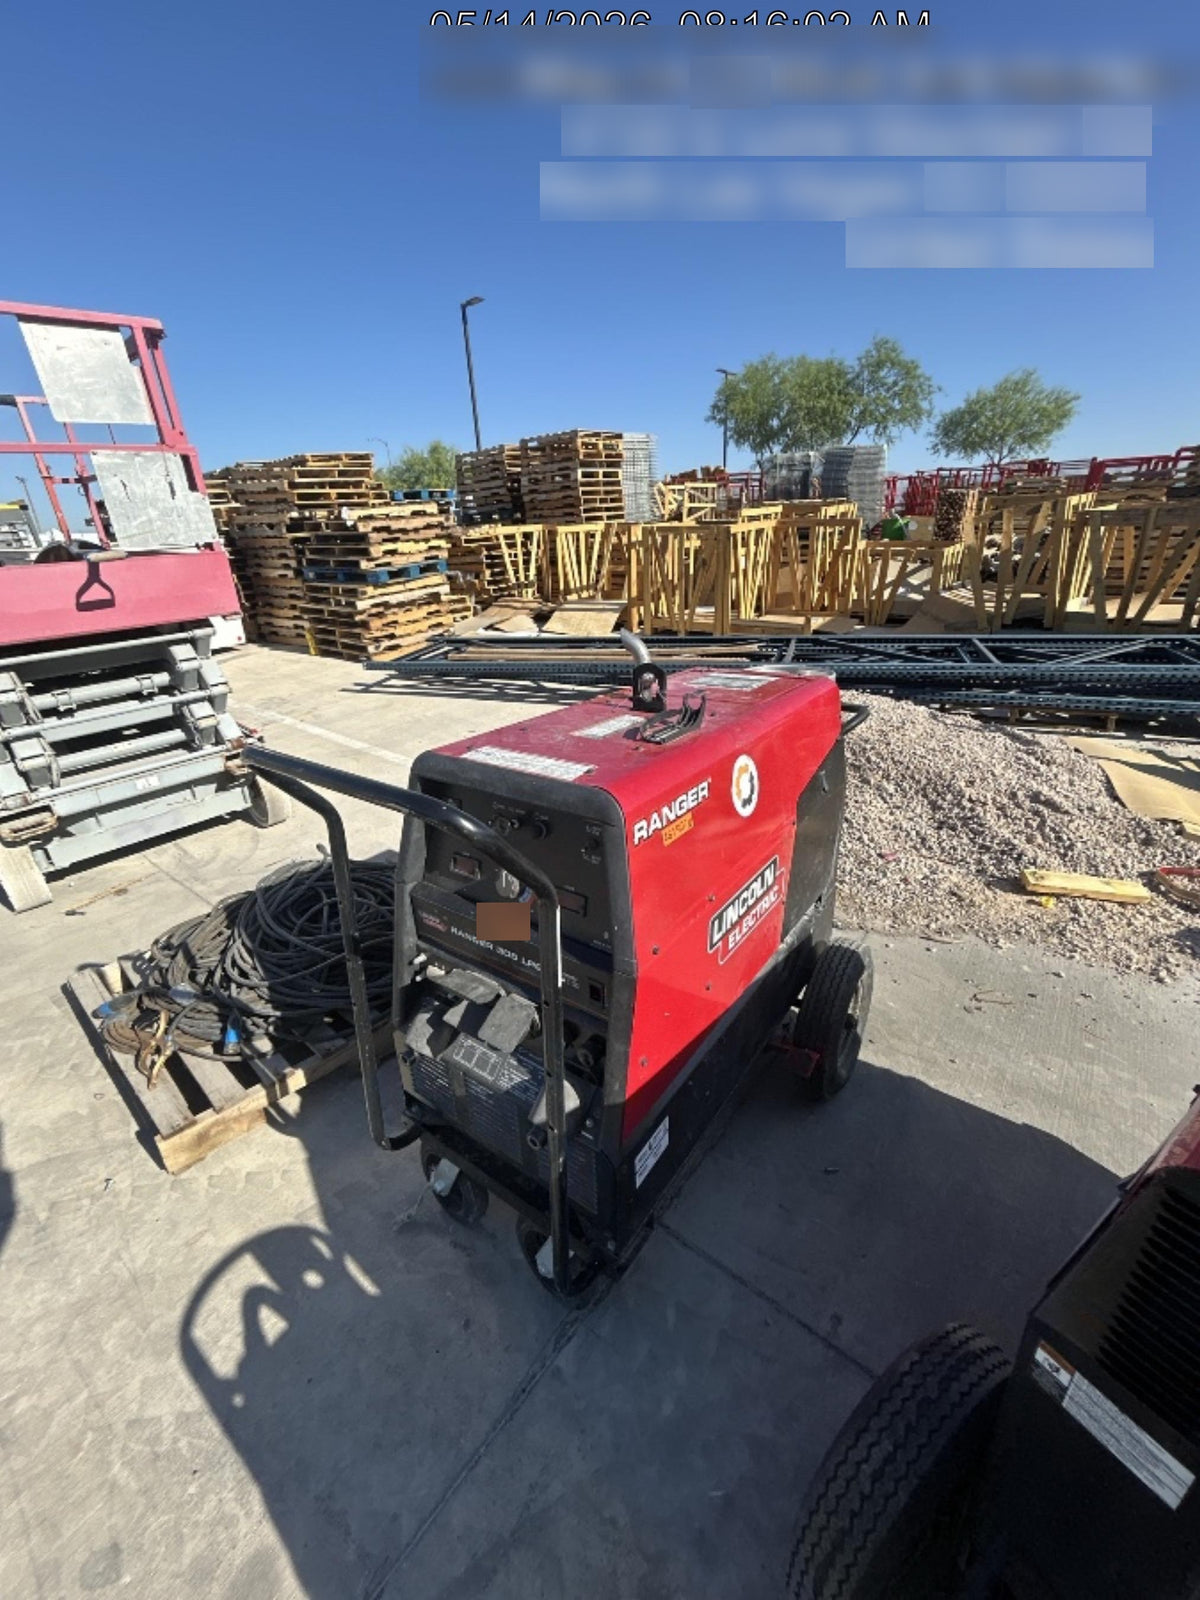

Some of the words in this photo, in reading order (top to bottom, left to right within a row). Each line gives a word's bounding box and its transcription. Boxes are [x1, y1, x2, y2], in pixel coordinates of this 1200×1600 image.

[633, 780, 709, 846] RANGER
[712, 863, 775, 945] LINCOLN
[728, 884, 779, 950] ELECTRIC
